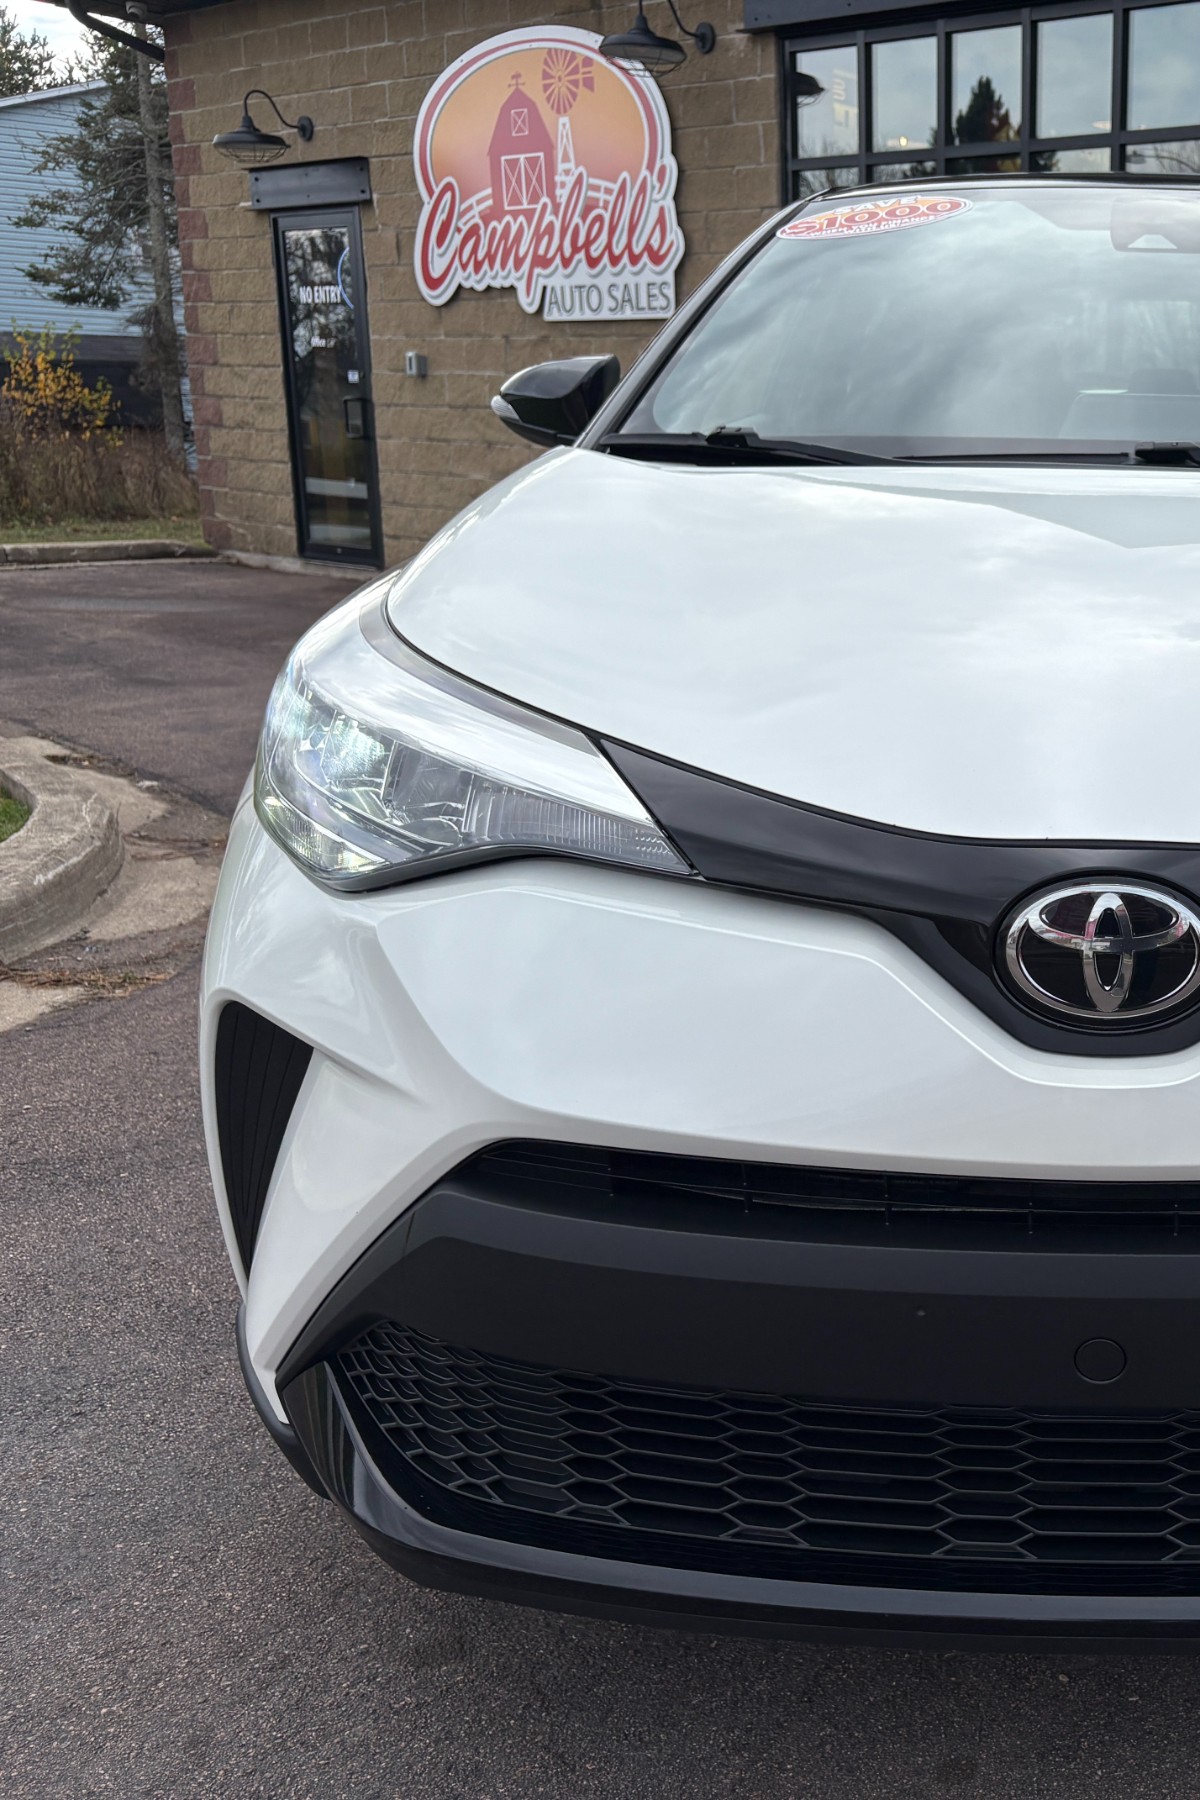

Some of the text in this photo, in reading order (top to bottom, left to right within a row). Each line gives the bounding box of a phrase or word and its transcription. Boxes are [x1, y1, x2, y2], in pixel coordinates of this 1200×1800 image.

[784, 201, 964, 235] $1000
[834, 195, 920, 214] SAVE
[421, 164, 676, 298] Campbell's
[299, 285, 341, 304] NO ENTRY
[547, 281, 671, 314] AUTO SALES
